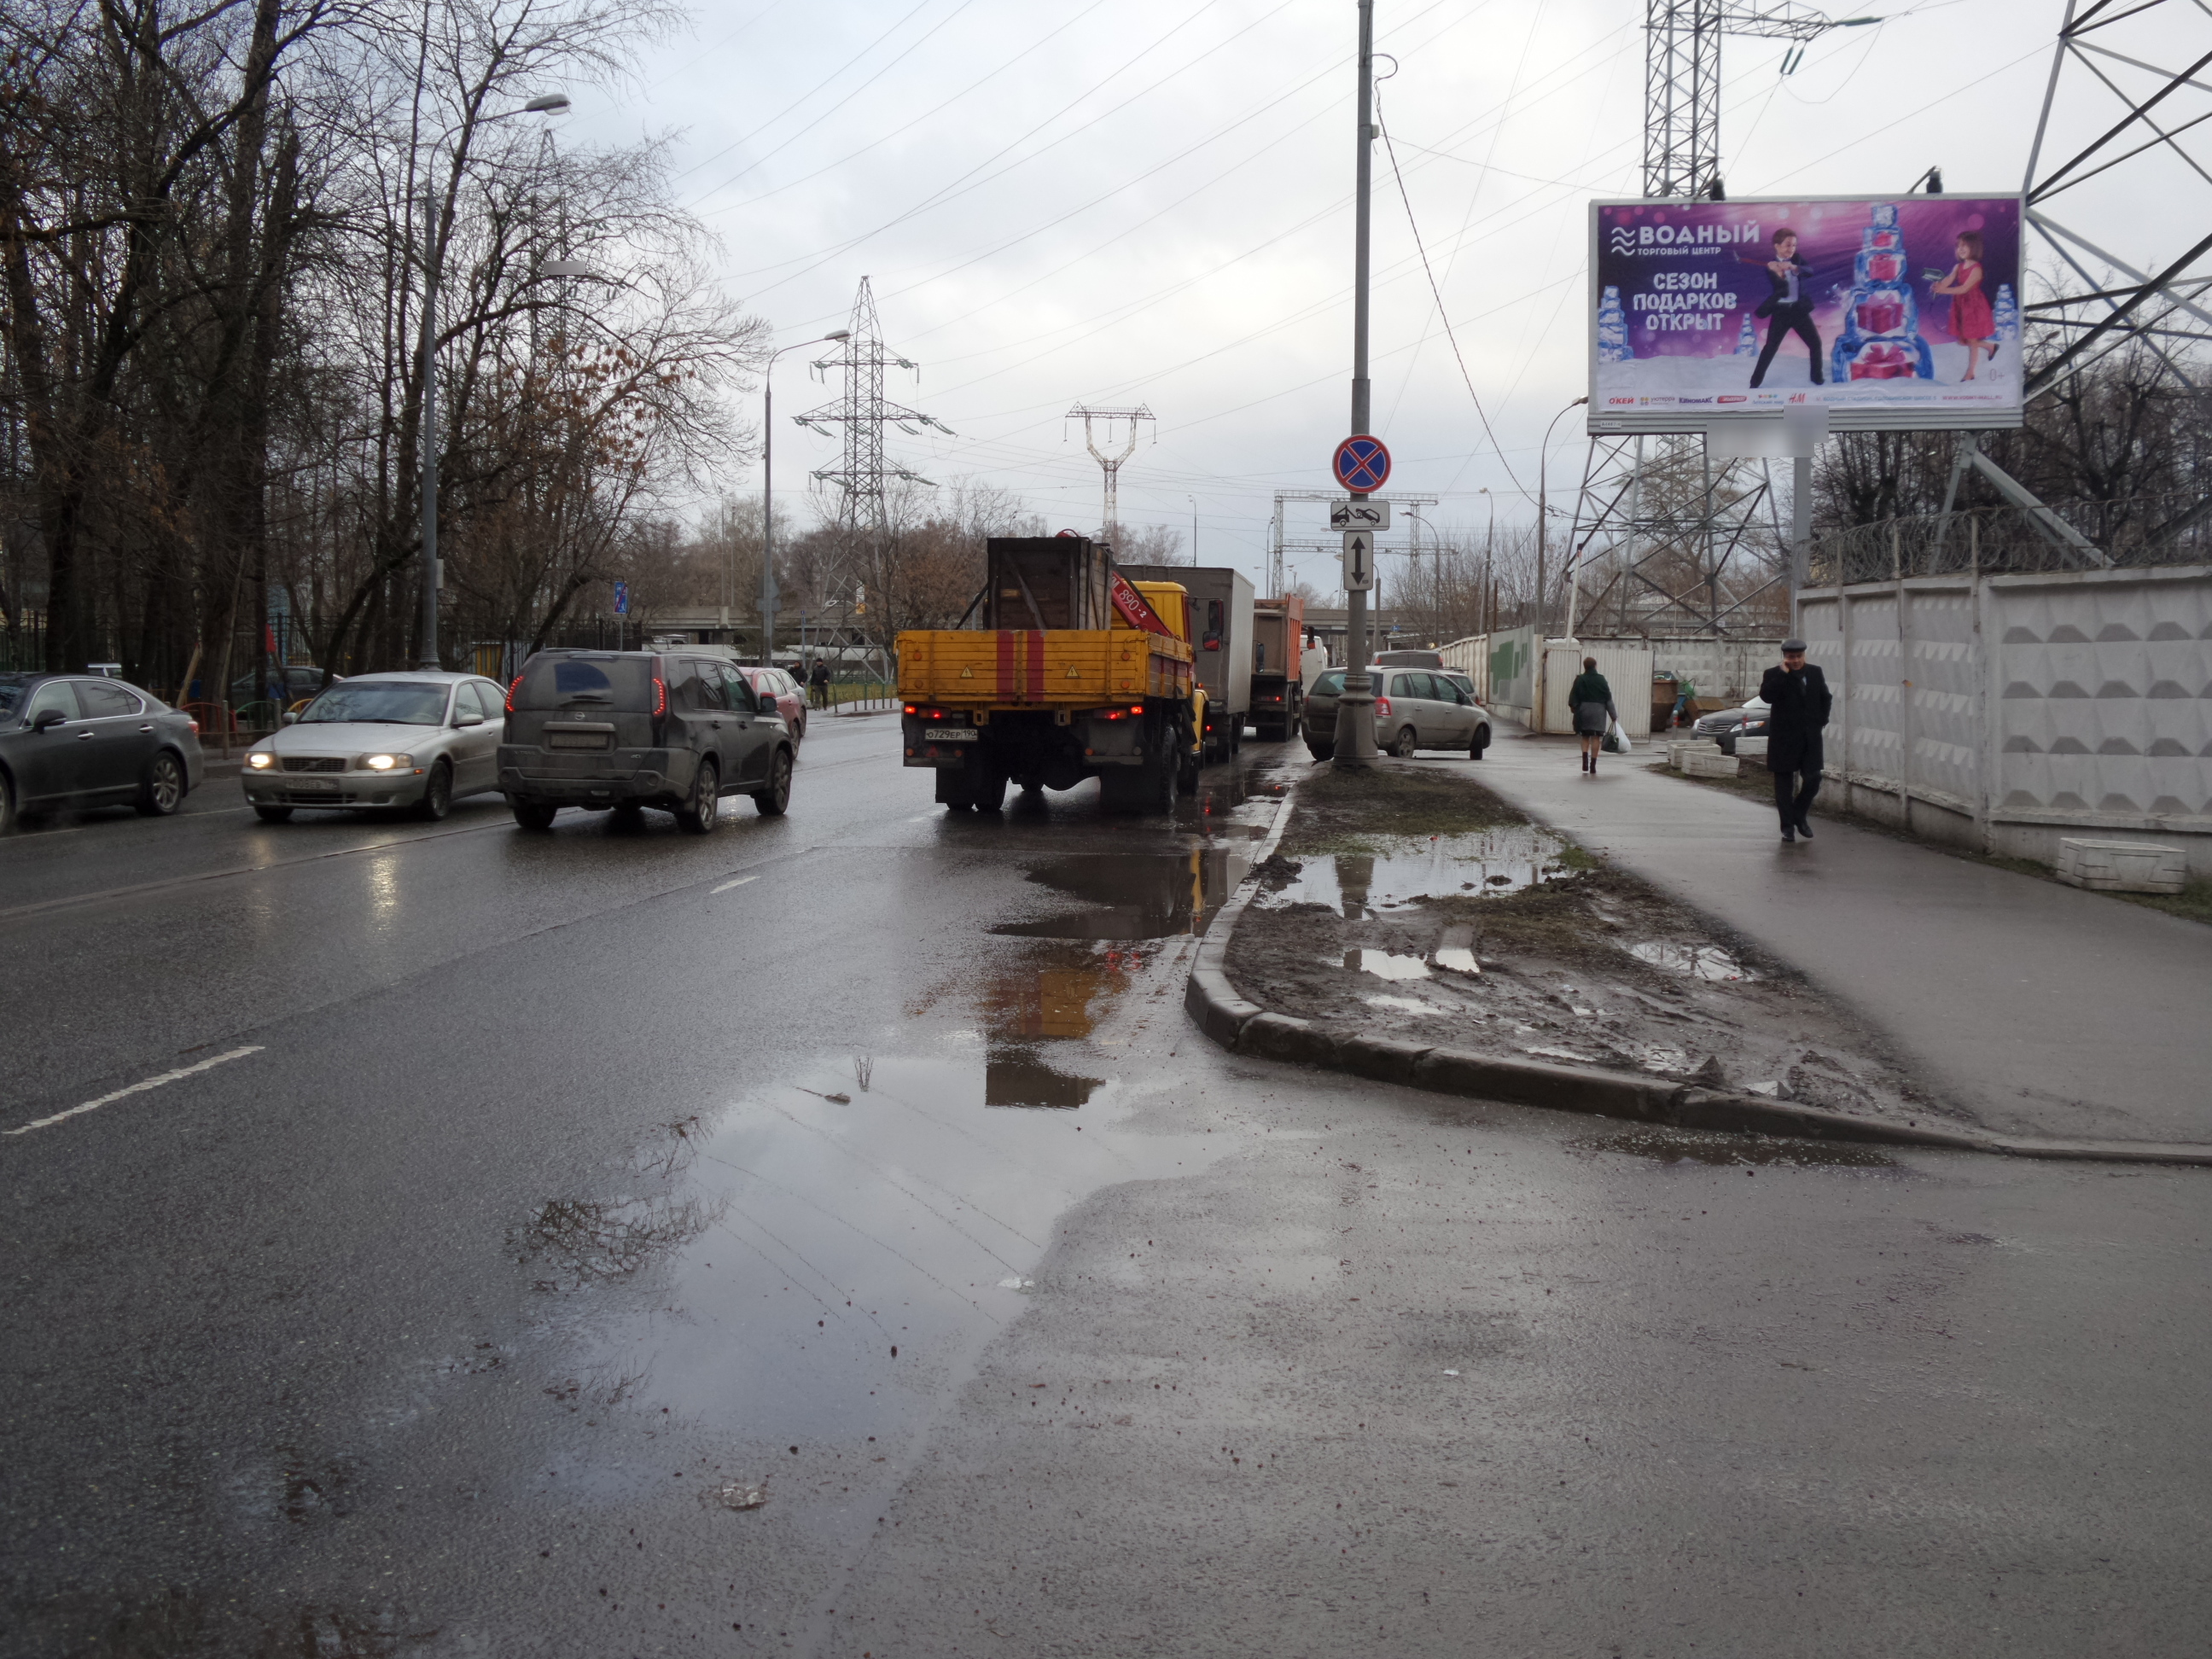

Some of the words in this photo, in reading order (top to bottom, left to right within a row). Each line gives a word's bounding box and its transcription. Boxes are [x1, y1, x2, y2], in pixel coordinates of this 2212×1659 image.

[1639, 219, 1761, 245] ВОДНЫЙ
[1637, 246, 1690, 256] ТОРГОВЫЙ
[1691, 247, 1722, 256] ЦЕНТР
[1653, 271, 1718, 290] СЕЗОН
[1633, 292, 1738, 313] ПОДАРКОВ
[1645, 312, 1726, 331] ОТКРЫТ
